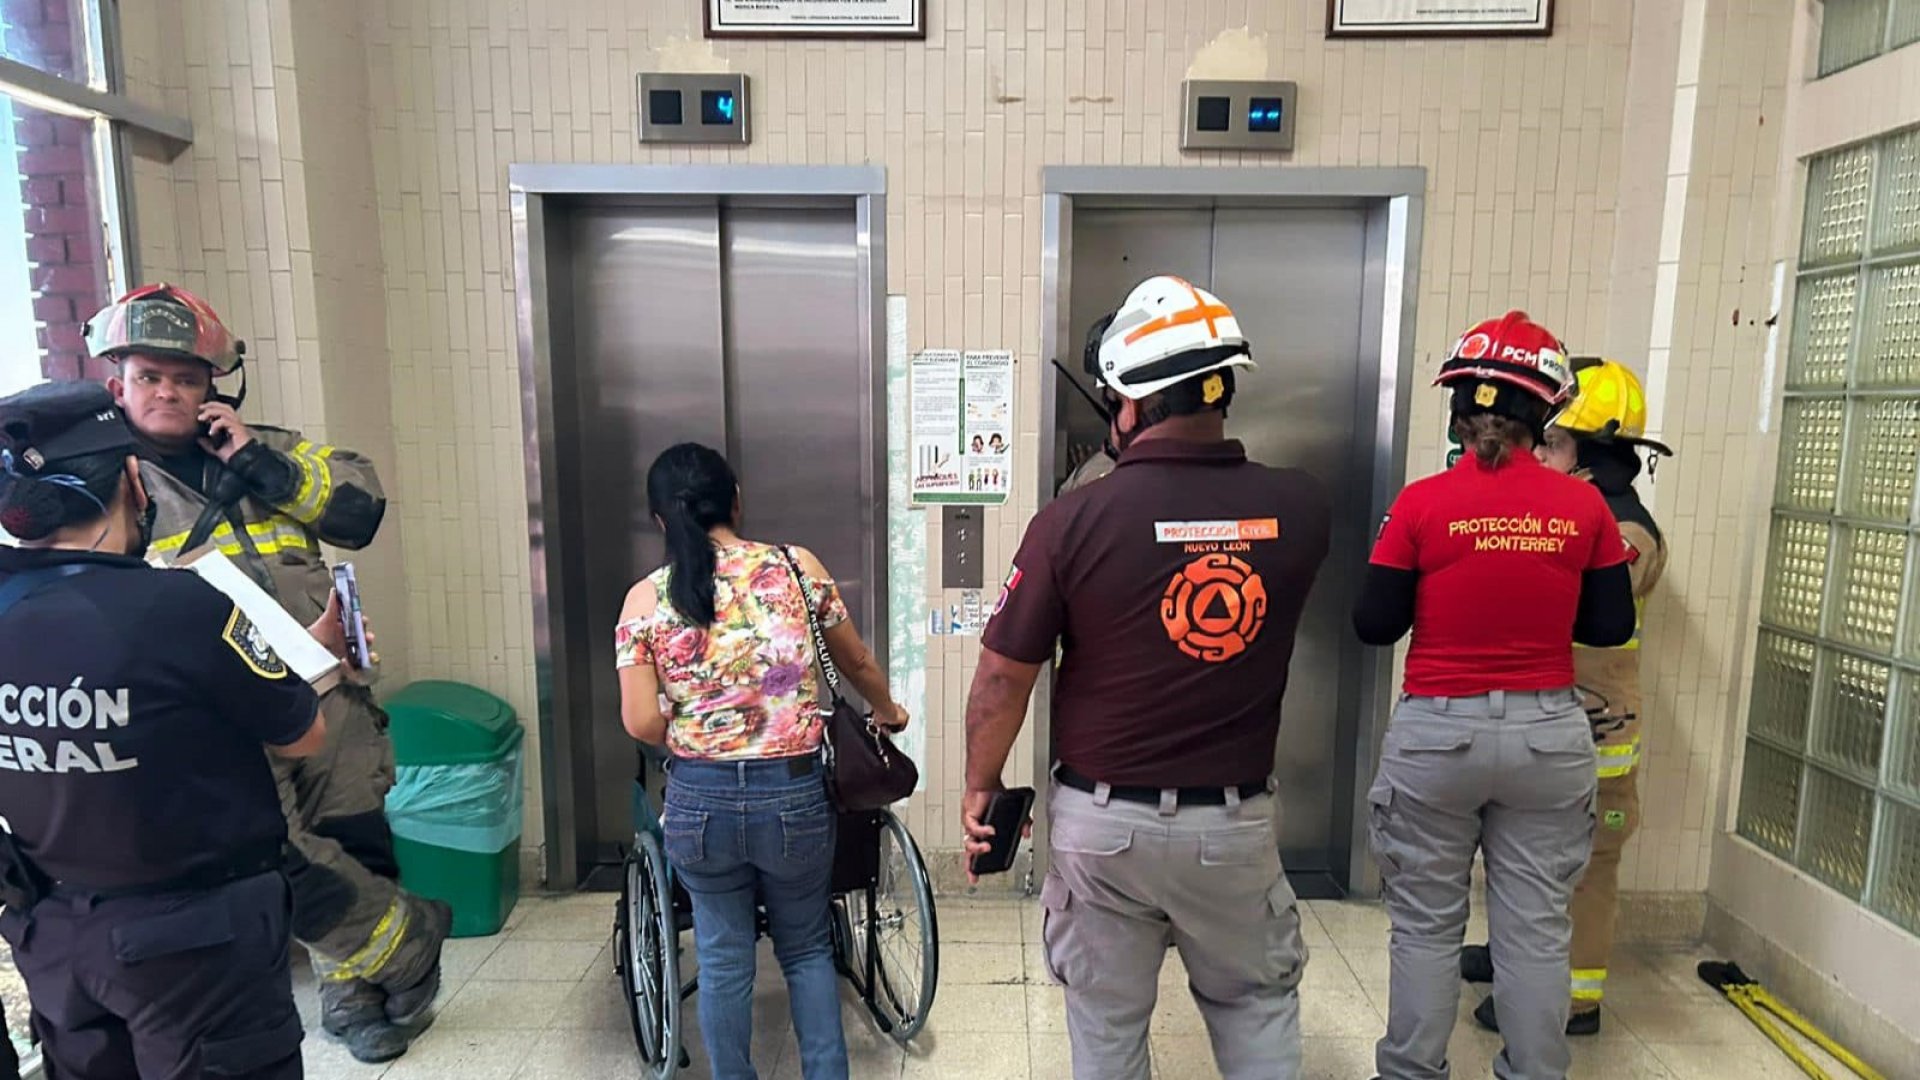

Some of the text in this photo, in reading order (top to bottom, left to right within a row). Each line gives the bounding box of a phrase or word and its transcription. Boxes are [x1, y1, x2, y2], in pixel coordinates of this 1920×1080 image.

[718, 96, 733, 118] 4
[1501, 345, 1538, 366] PCM
[1449, 512, 1579, 537] PROTECCIÓN CIVIL
[1184, 541, 1219, 553] NUEVO
[1474, 535, 1566, 552] MONTERREY
[0, 676, 130, 730] CCIÓN
[0, 734, 139, 774] ERAL
